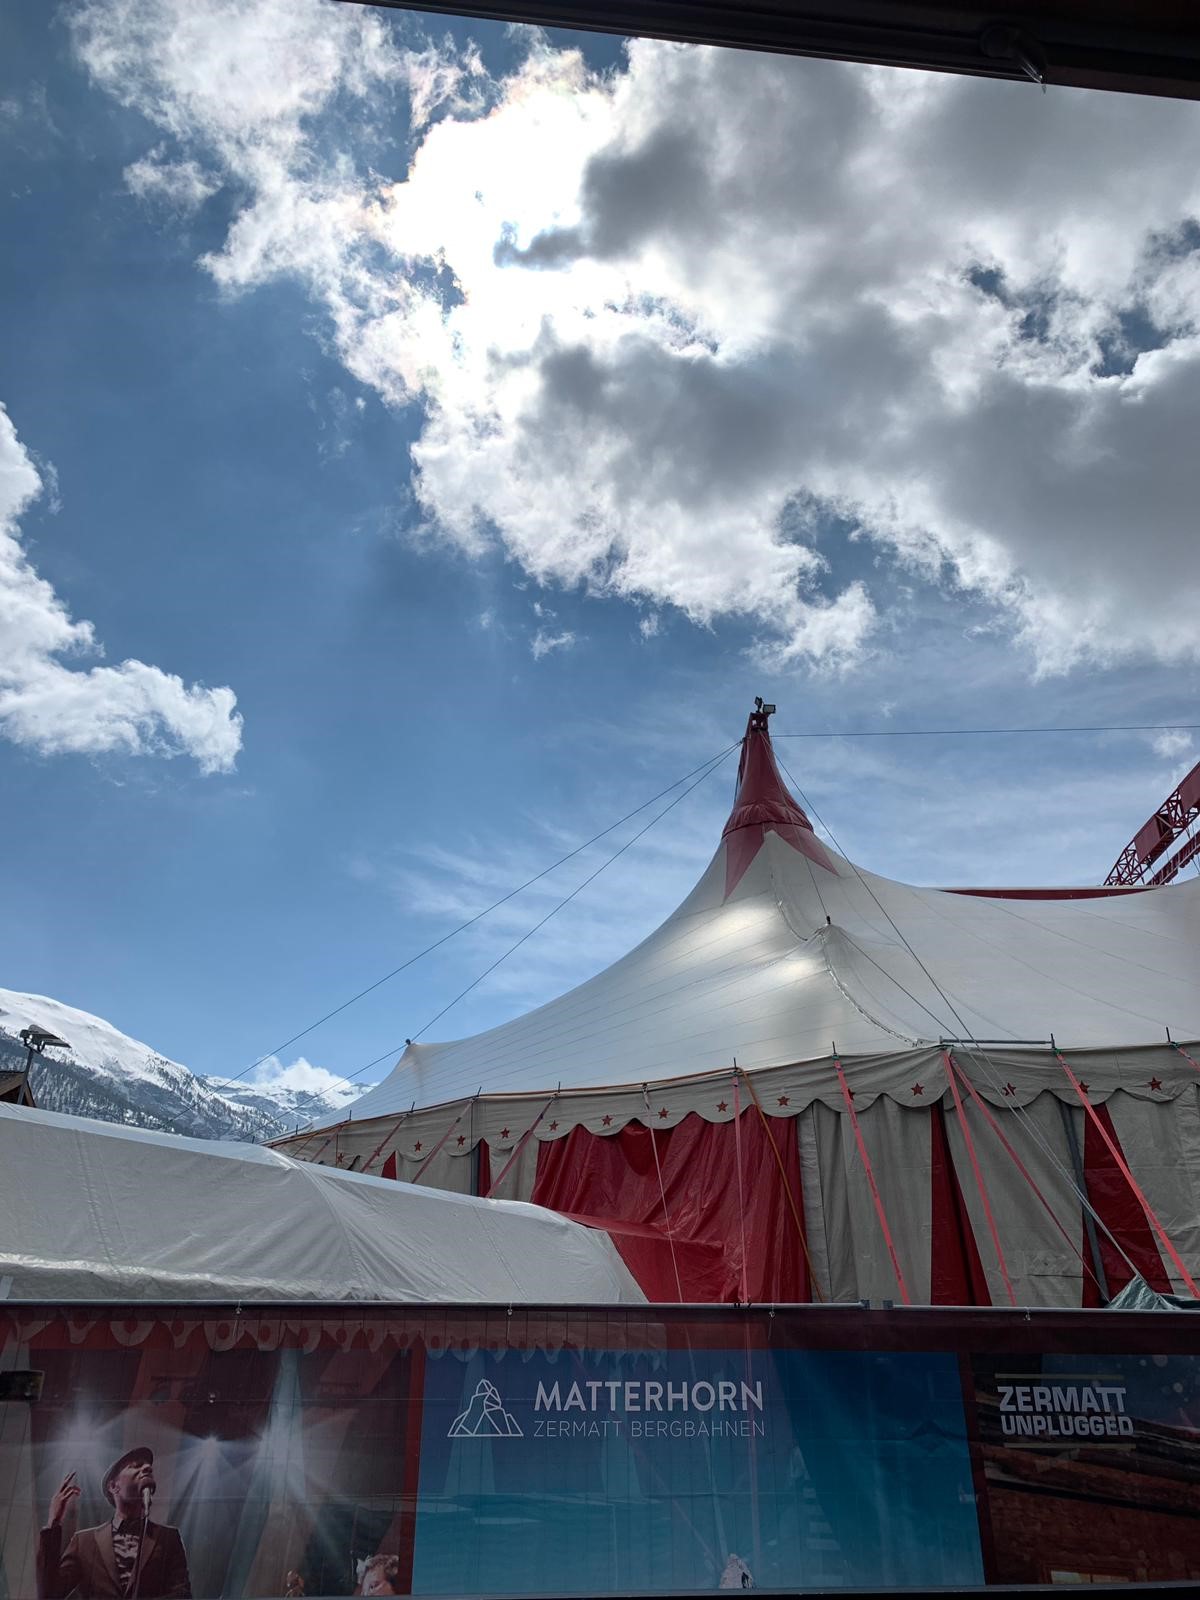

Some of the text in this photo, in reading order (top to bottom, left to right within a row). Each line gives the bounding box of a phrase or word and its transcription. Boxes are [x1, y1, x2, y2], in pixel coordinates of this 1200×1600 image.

[534, 1381, 764, 1412] MATTERHORN
[997, 1386, 1126, 1413] ZERMATT
[533, 1420, 766, 1438] ZERMATT BERGBAHNEN
[1001, 1415, 1134, 1436] UNPLUGGED
